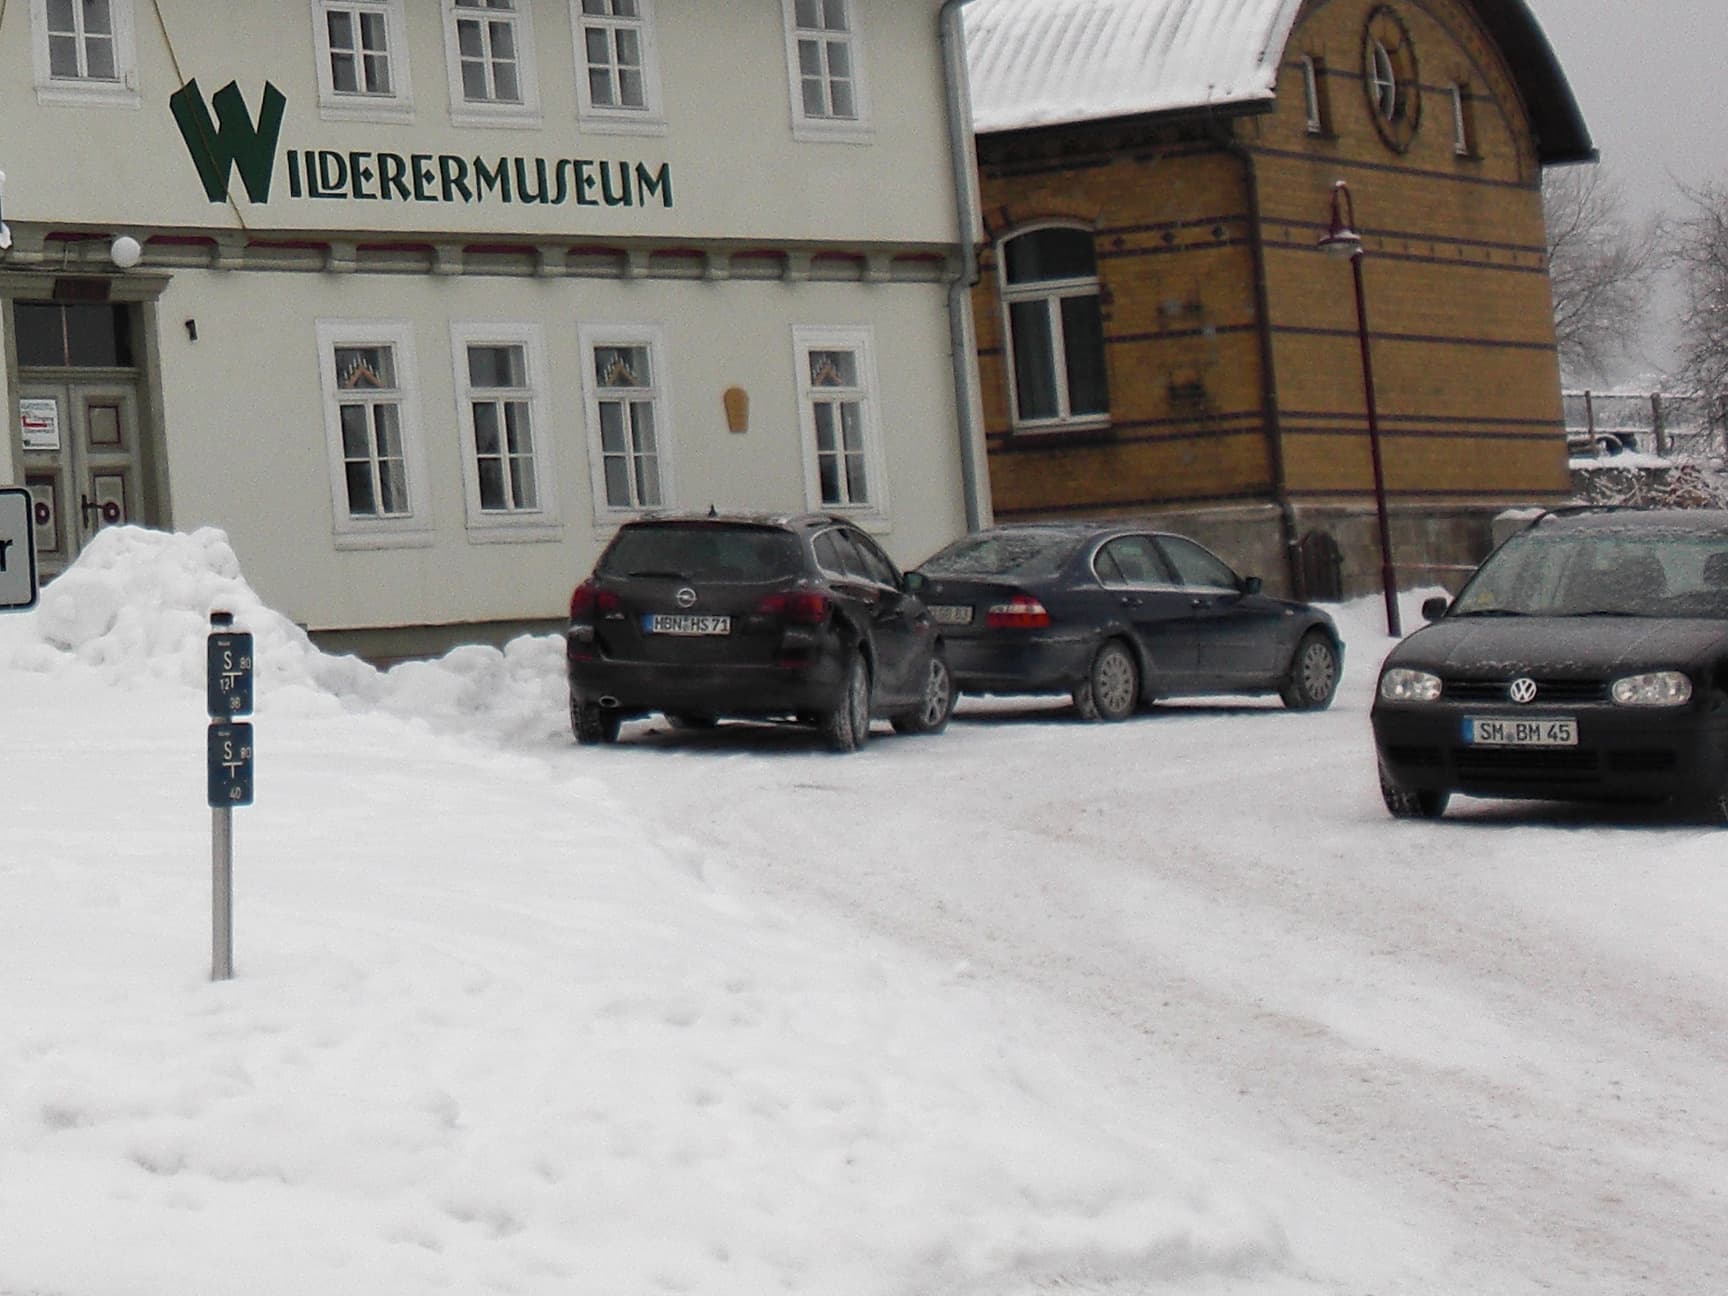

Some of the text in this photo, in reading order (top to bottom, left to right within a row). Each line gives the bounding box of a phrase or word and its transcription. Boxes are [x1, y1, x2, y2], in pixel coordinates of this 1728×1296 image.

[168, 77, 674, 209] WILDERERMUSEUM
[691, 617, 709, 632] HS
[712, 618, 729, 633] 71
[223, 651, 232, 670] S
[1479, 722, 1571, 742] SM BM 45
[223, 741, 232, 760] S
